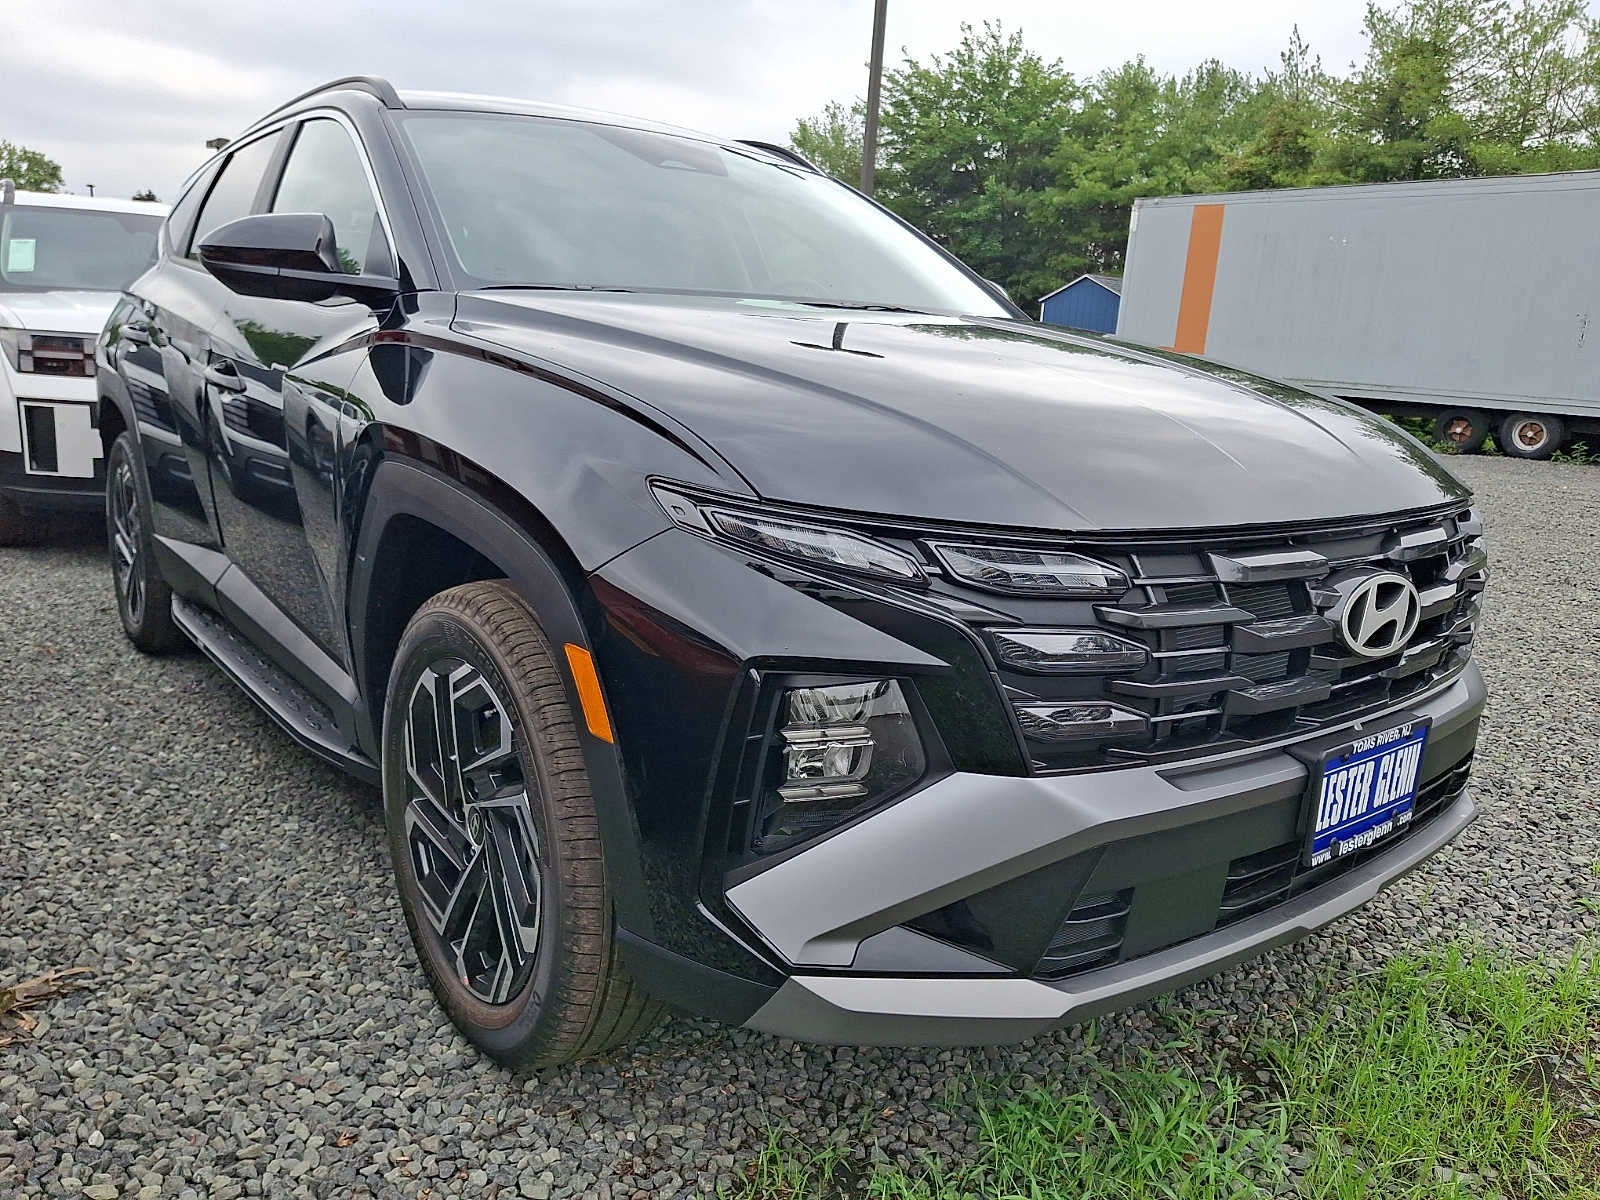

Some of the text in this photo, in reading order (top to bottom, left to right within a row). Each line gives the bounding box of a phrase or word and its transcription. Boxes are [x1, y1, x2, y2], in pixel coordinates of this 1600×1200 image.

[1352, 736, 1376, 755] TOMS
[1401, 723, 1412, 738] NJ
[1315, 743, 1422, 832] LESTER GLENN
[1338, 820, 1393, 856] lesterglenn
